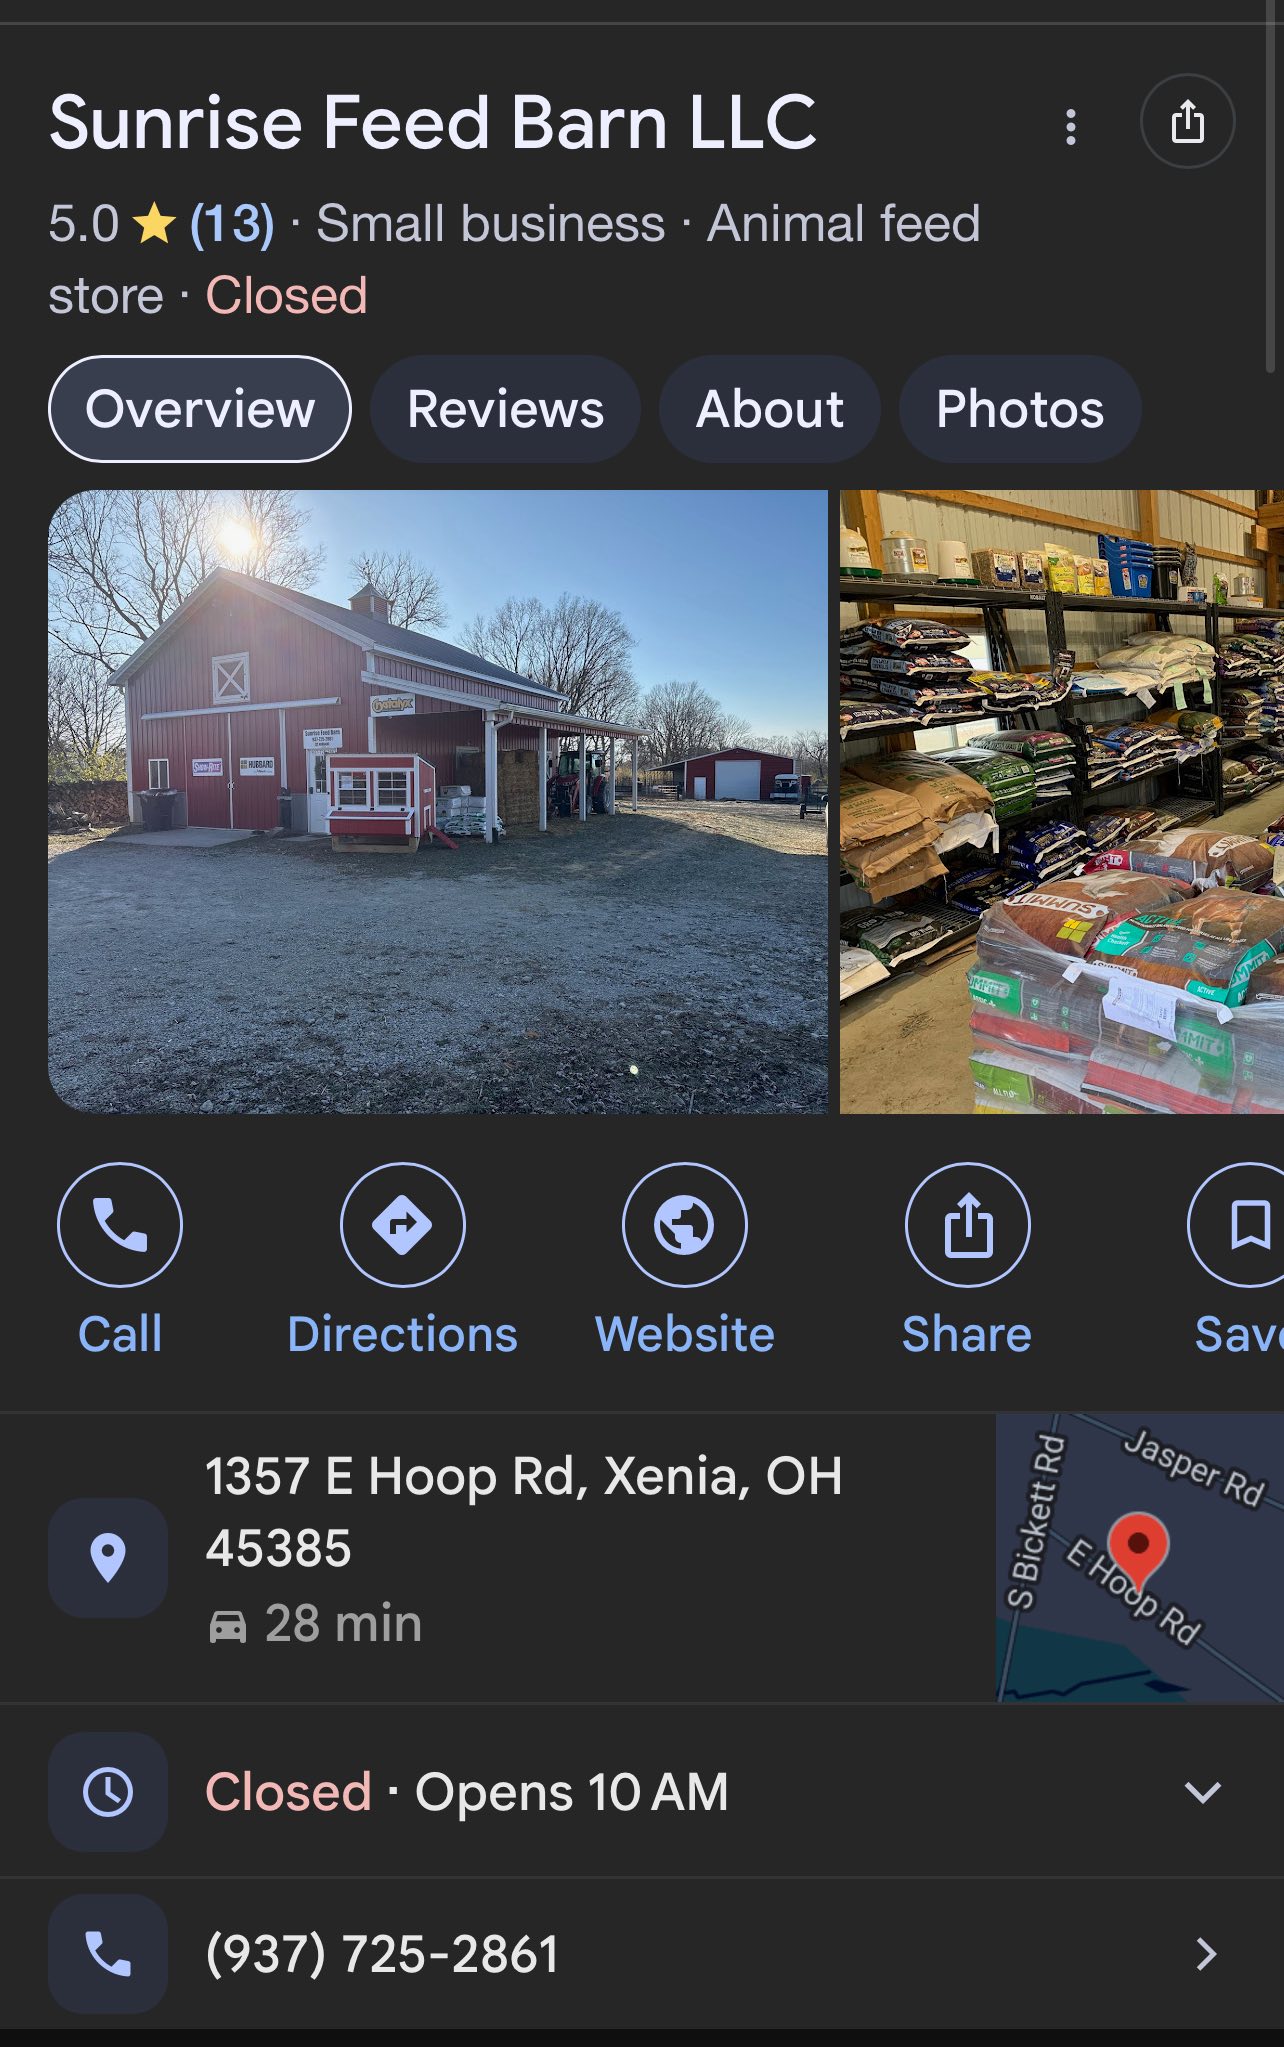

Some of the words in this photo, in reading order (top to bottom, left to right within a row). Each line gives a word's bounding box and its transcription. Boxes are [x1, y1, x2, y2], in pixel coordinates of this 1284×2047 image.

[50, 93, 301, 149] Sunrise
[327, 94, 487, 149] Feed
[515, 94, 665, 149] Barn
[693, 93, 816, 149] LLC
[50, 204, 118, 242] 5.0
[191, 202, 273, 251] (13)
[318, 203, 442, 242] Small
[463, 204, 665, 242] business
[707, 203, 862, 242] Animal
[880, 203, 979, 242] feed
[49, 278, 163, 314] store
[207, 275, 366, 314] Closed
[86, 387, 315, 428] Overview
[410, 387, 604, 428] Reviews
[696, 387, 843, 428] About
[939, 387, 1104, 428] Photos
[248, 760, 273, 769] HUBBARD
[1012, 894, 1097, 914] SUMMIT
[1197, 985, 1217, 997] ACTIVE
[79, 1313, 160, 1352] Call
[290, 1313, 517, 1352] Directions
[595, 1313, 774, 1352] Website
[903, 1313, 1031, 1352] Share
[1196, 1315, 1284, 1352] Sav
[1034, 1434, 1065, 1473] Rd
[1124, 1430, 1220, 1487] Jasper
[1223, 1471, 1265, 1508] Rd
[206, 1456, 309, 1495] 1357
[328, 1456, 352, 1494] E
[371, 1456, 496, 1505] Hoop
[515, 1454, 587, 1500] Rd,
[604, 1454, 749, 1500] Xenia,
[767, 1456, 840, 1495] OH
[206, 1528, 350, 1567] 45385
[1012, 1480, 1056, 1582] Bickett
[1007, 1588, 1033, 1610] S
[1066, 1538, 1093, 1567] E
[1088, 1554, 1158, 1618] Hoop
[1160, 1606, 1202, 1646] Rd
[267, 1603, 319, 1642] 28
[337, 1601, 420, 1641] min
[206, 1770, 370, 1811] Closed
[416, 1772, 573, 1822] Opens
[589, 1772, 640, 1811] 10
[651, 1772, 726, 1810] AM
[208, 1931, 324, 1980] (937)
[343, 1934, 555, 1973] 725-2861
